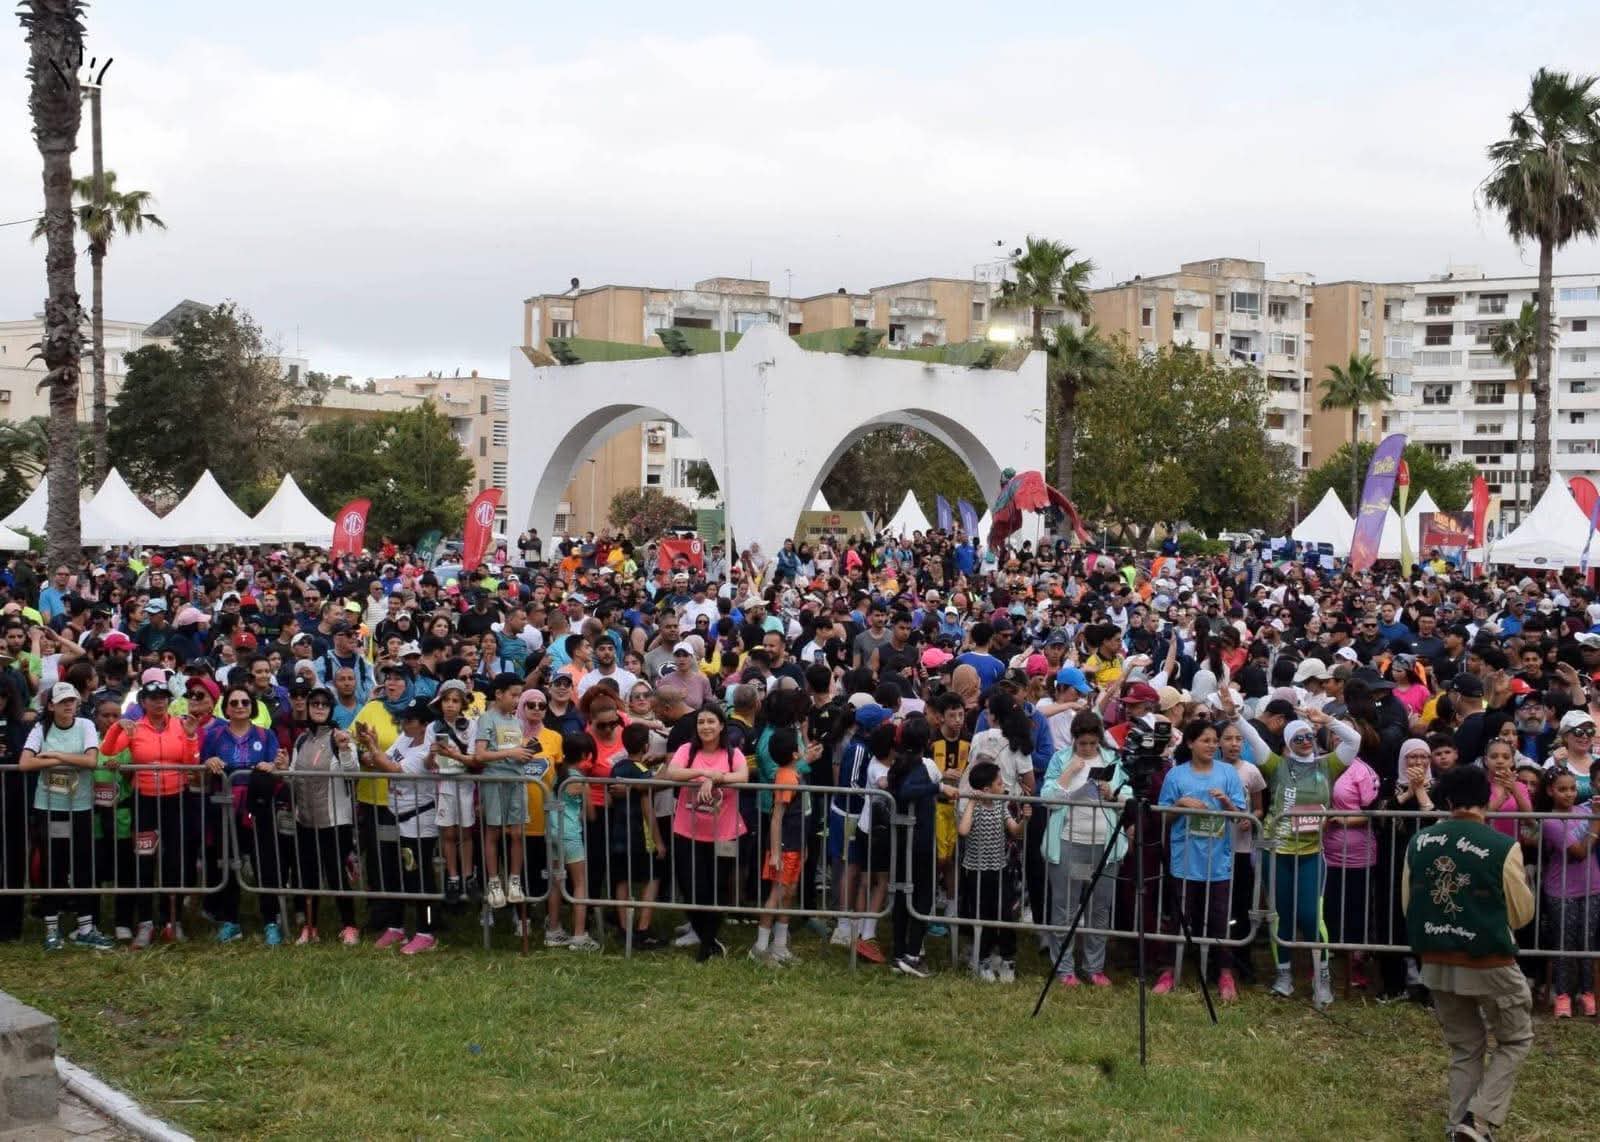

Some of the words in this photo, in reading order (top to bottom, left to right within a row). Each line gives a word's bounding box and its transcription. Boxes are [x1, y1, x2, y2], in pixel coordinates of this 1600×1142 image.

[344, 514, 363, 534] MG
[475, 503, 493, 525] MG
[947, 753, 955, 767] 3
